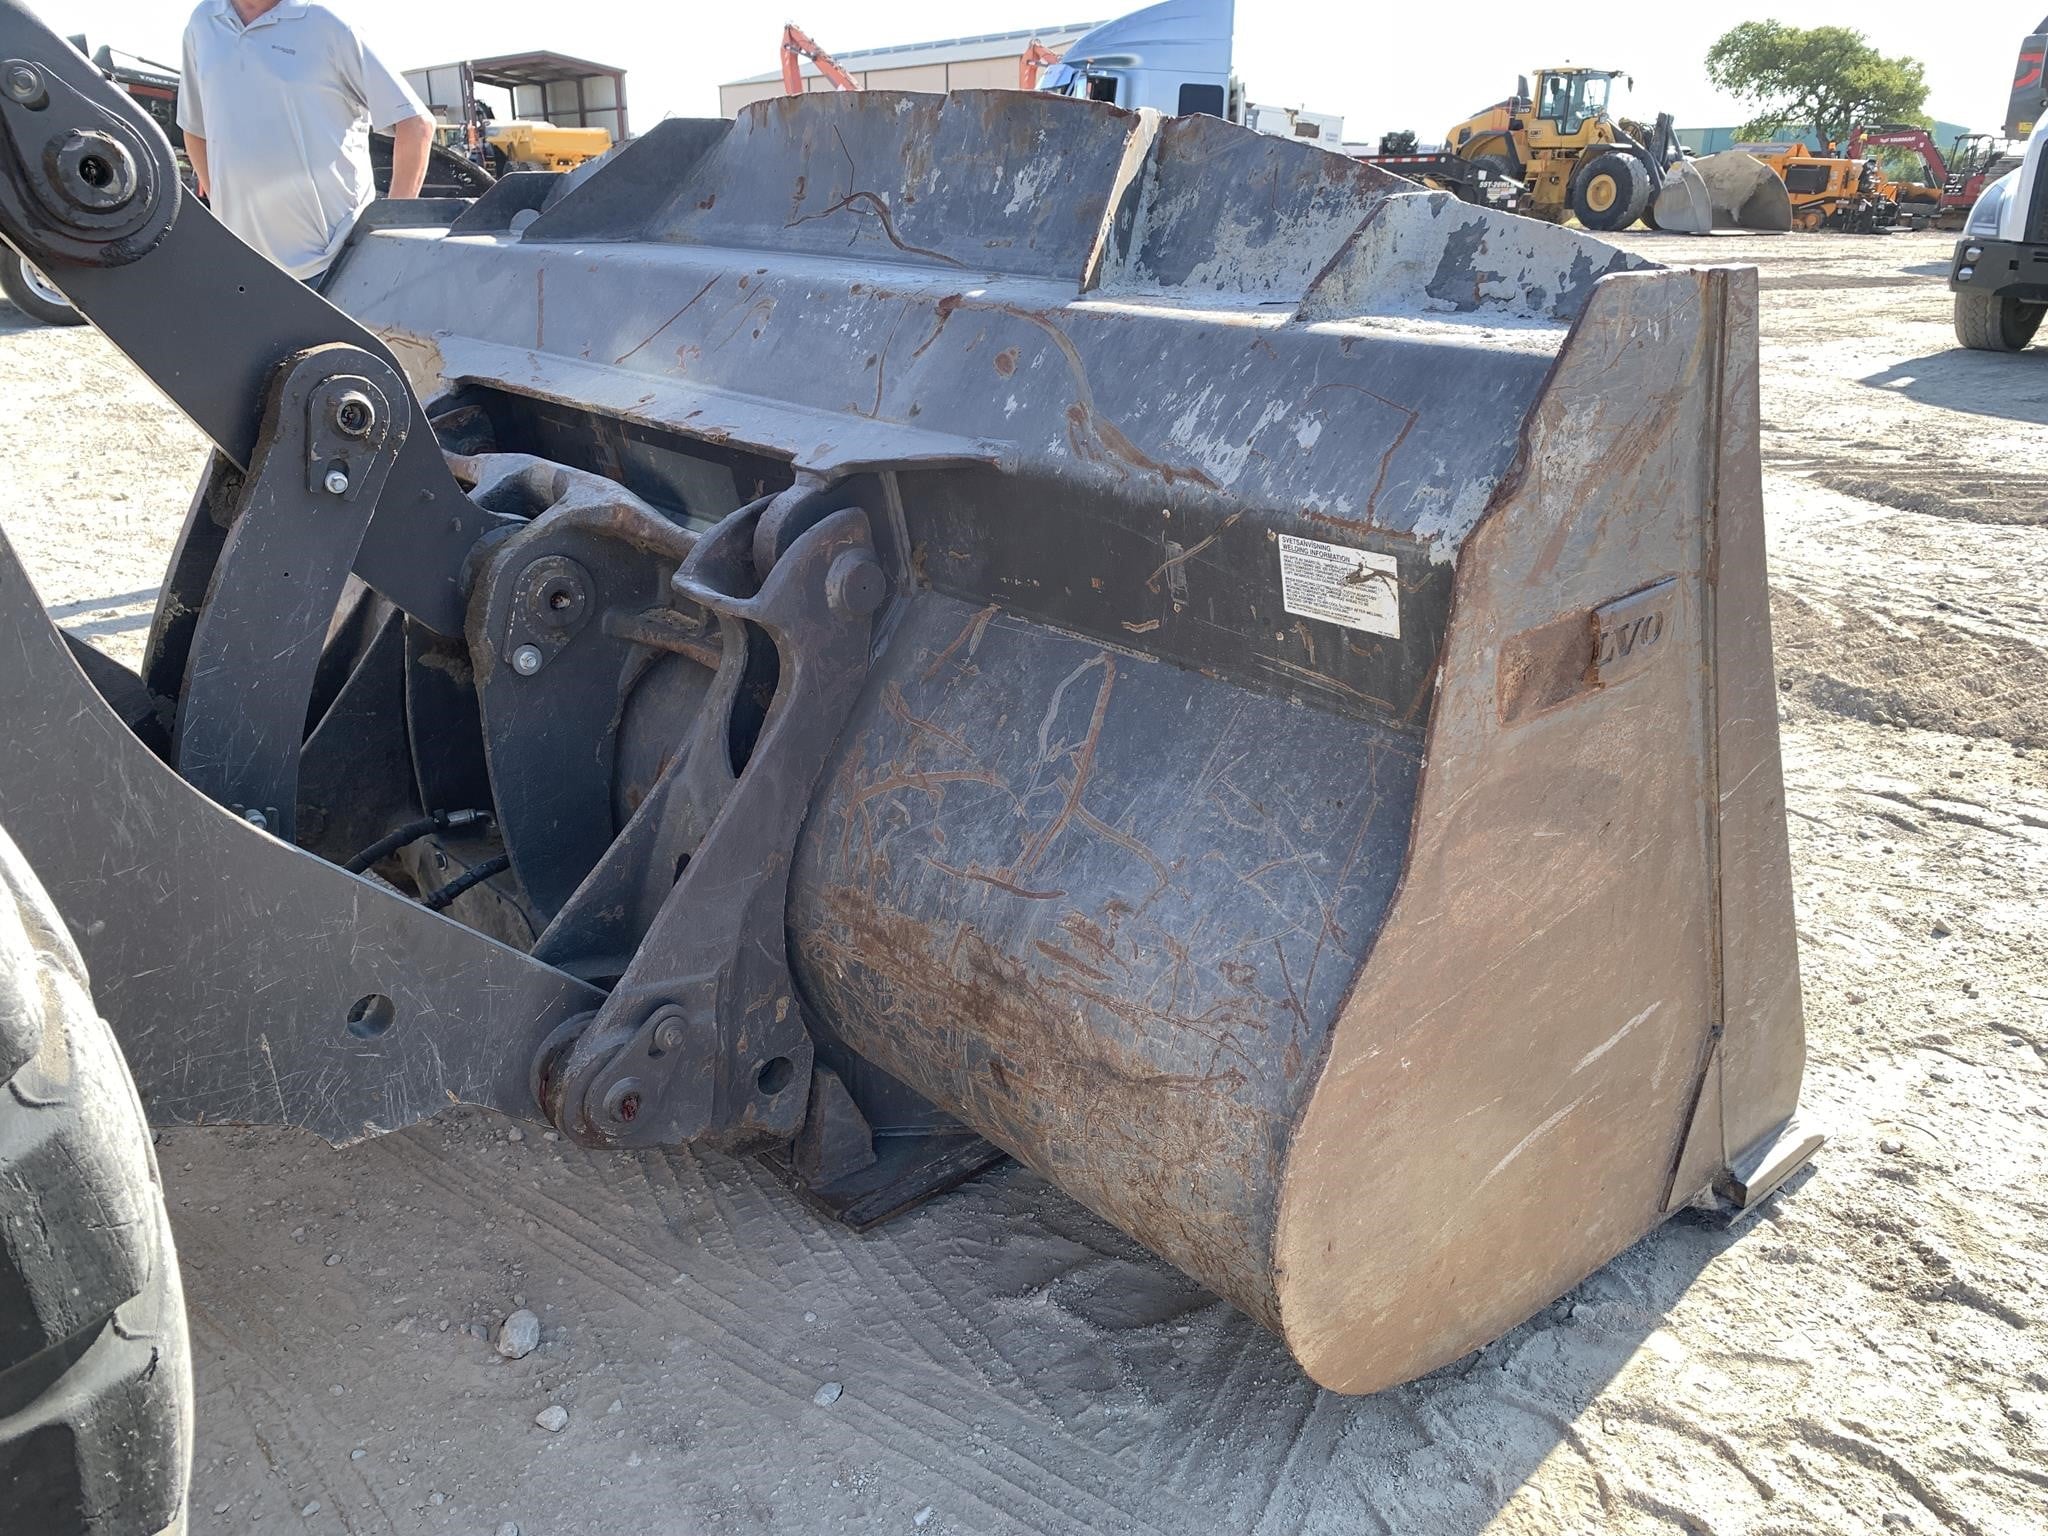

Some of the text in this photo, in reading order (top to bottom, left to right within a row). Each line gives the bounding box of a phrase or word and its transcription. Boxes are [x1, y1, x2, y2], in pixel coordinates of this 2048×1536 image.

[1281, 536, 1331, 552] SVETSANVISNING
[1282, 543, 1351, 563] WELDING INFORMATION
